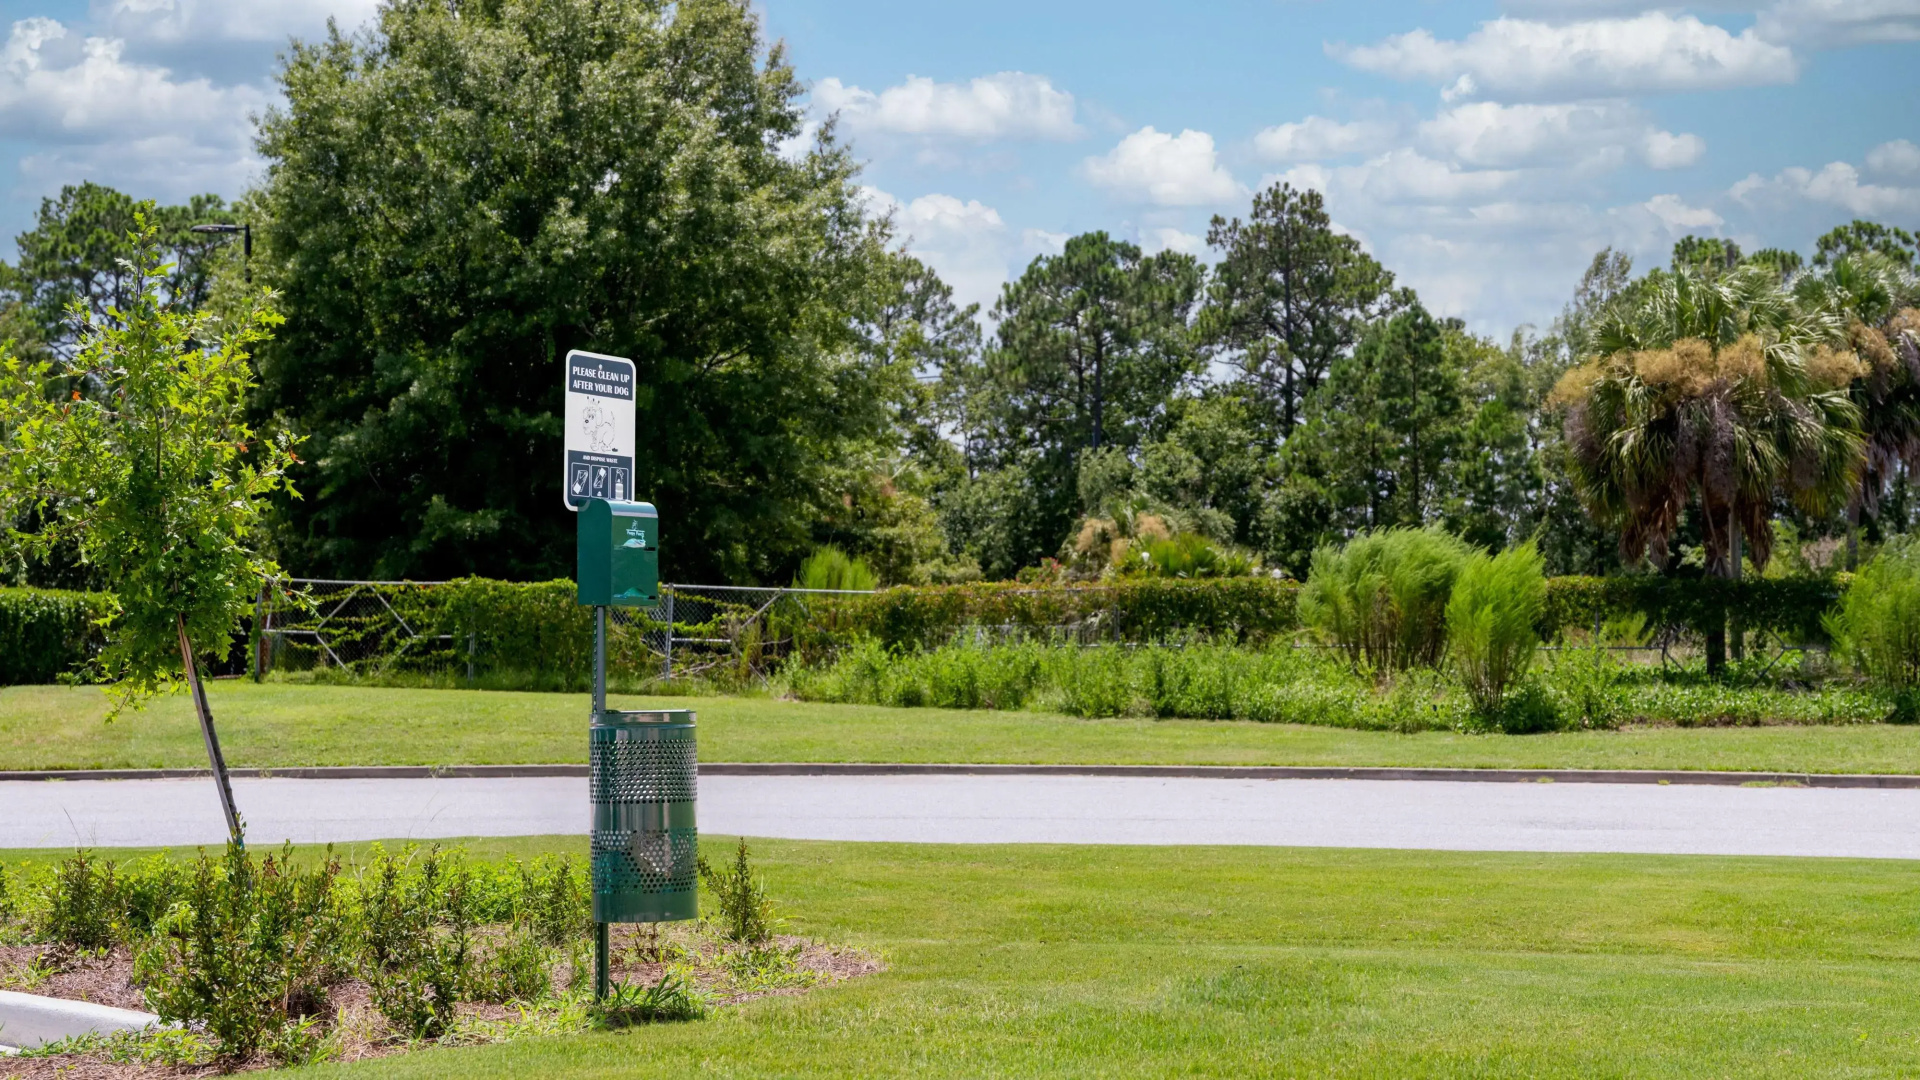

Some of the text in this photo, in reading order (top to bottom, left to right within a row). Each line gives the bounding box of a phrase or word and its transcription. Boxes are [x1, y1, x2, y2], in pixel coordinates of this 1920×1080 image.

[572, 366, 630, 383] PLEASE CLEAN UP
[572, 380, 629, 396] AFTER YOUR DOG
